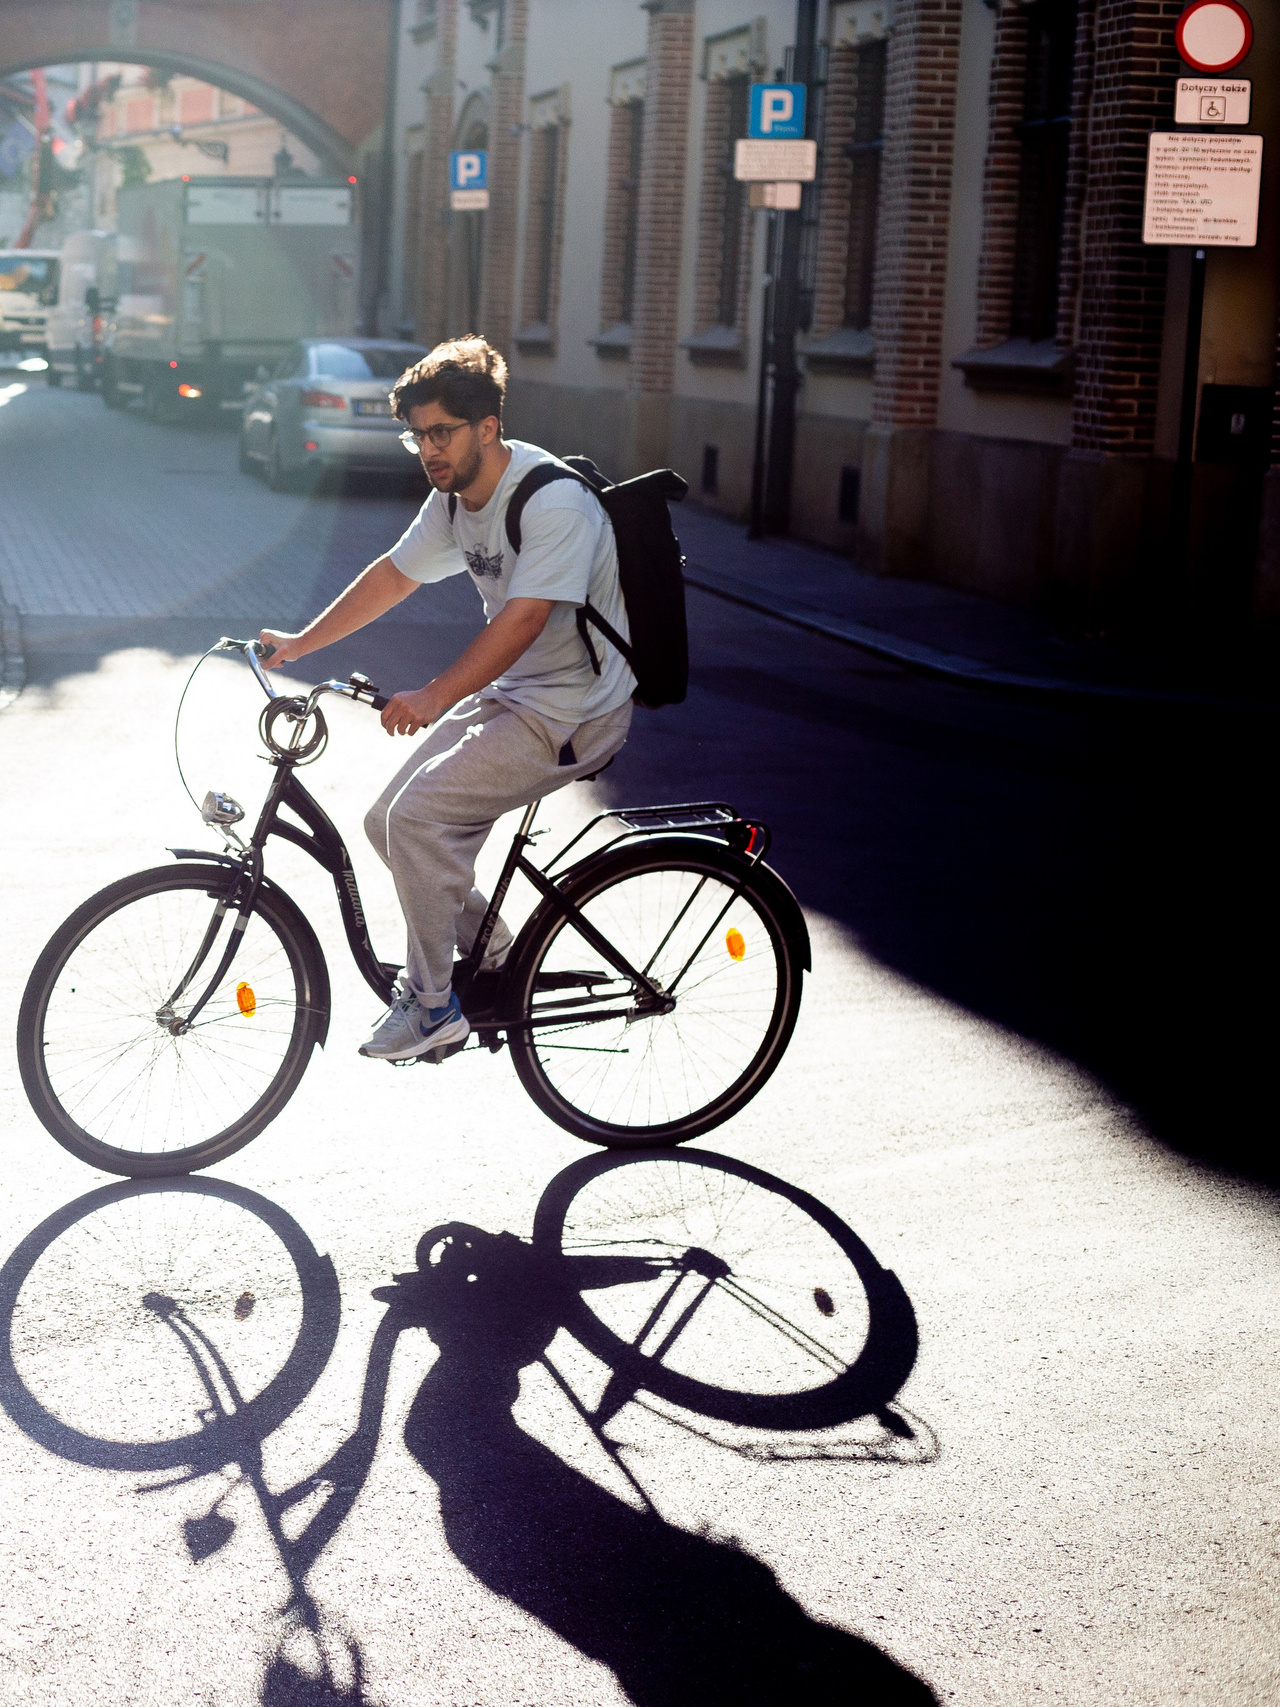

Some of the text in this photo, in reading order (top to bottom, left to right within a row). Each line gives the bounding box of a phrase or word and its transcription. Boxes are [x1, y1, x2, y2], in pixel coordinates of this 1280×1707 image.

[1181, 82, 1248, 94] Dotyczy także
[761, 88, 794, 134] P
[457, 154, 480, 186] P
